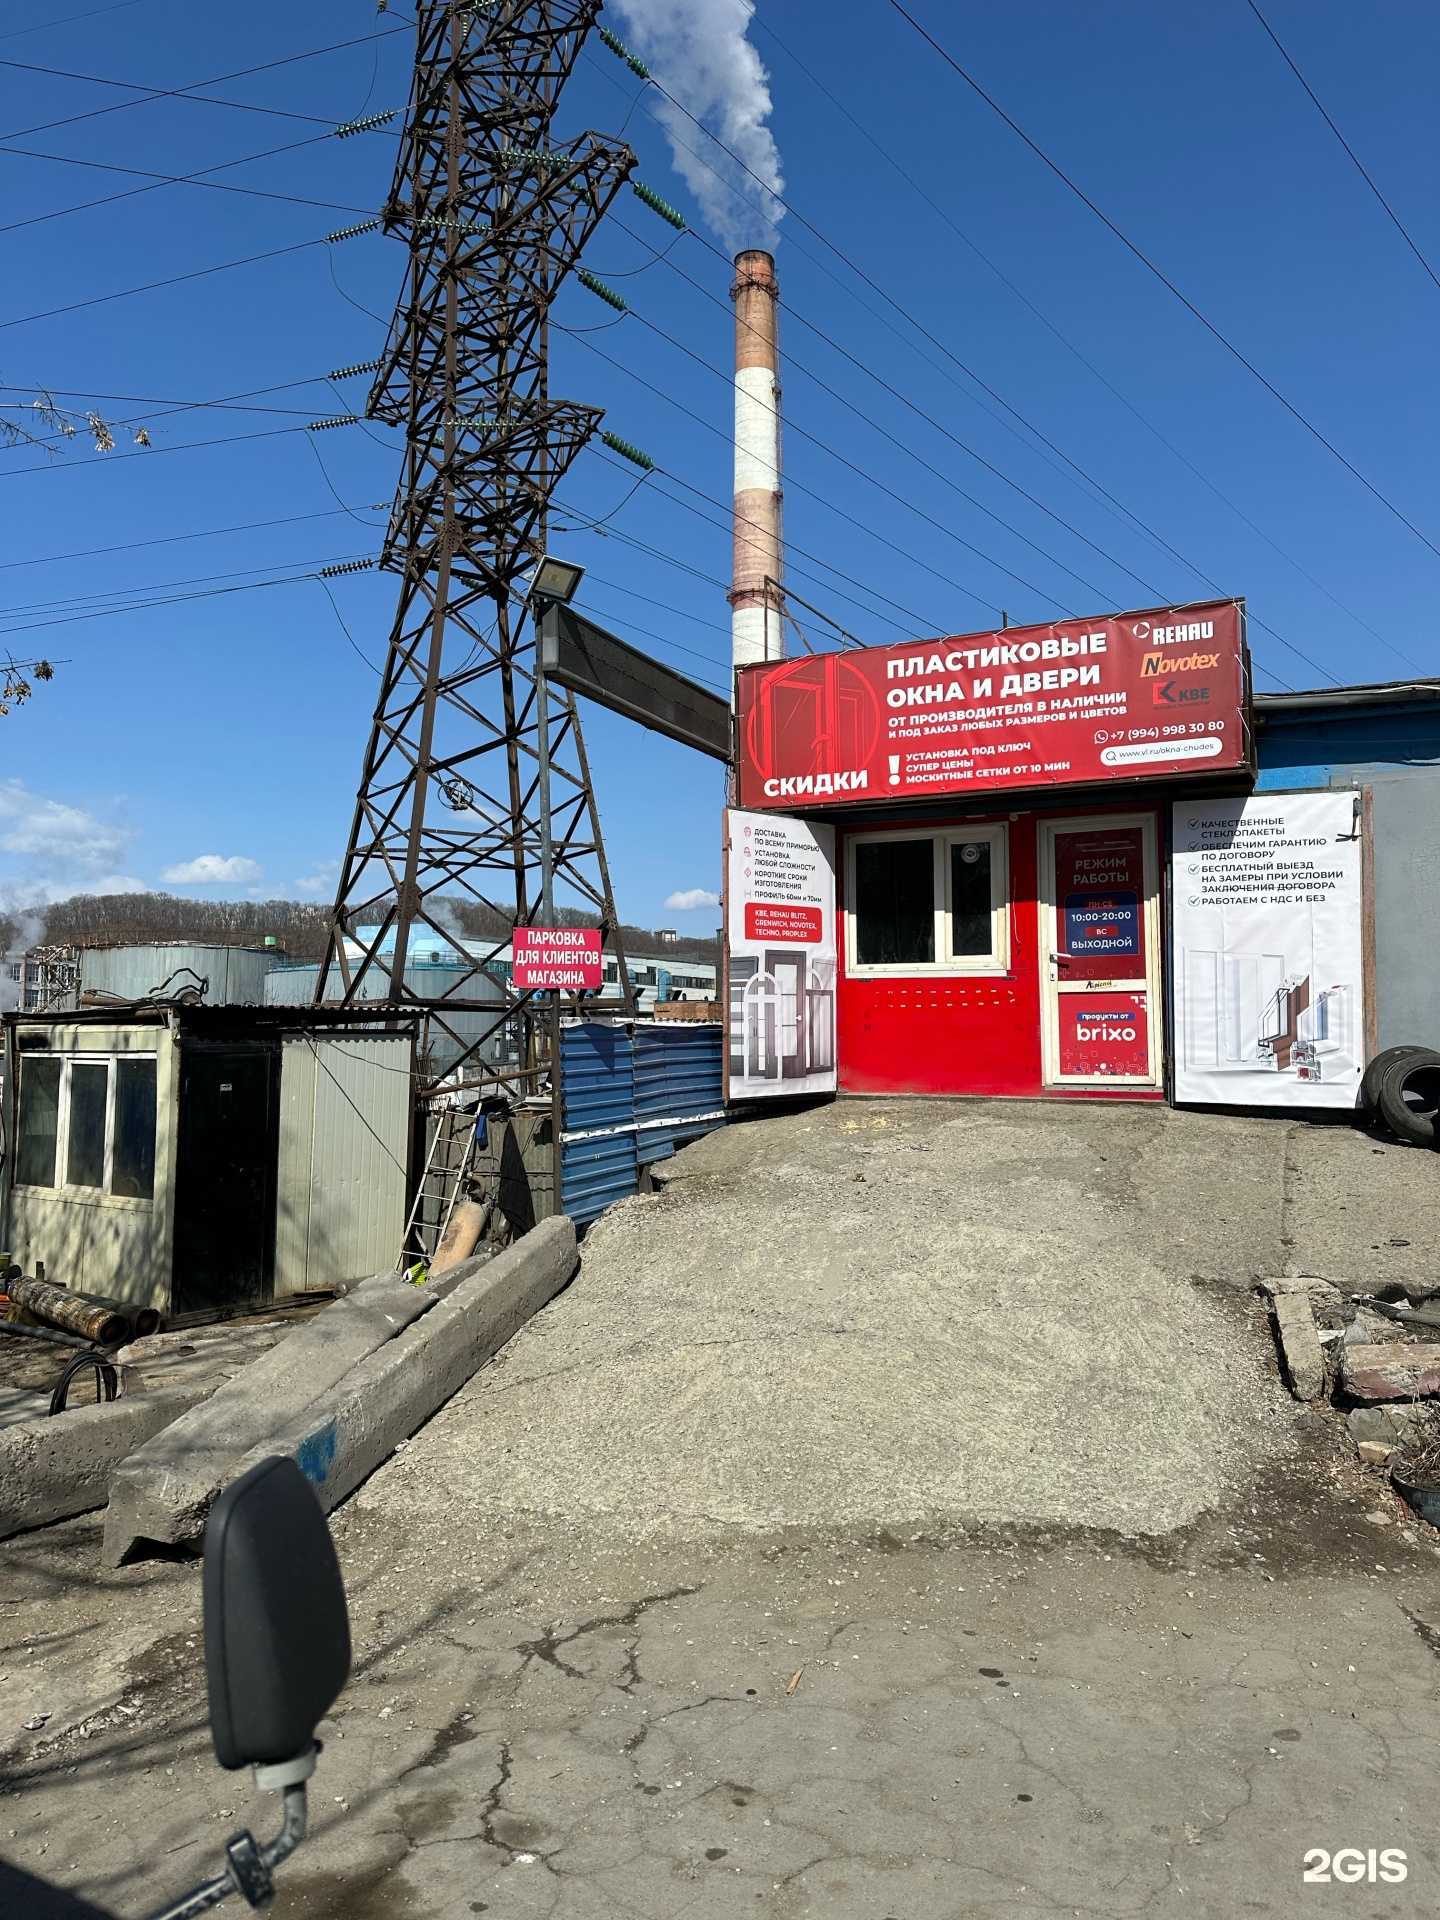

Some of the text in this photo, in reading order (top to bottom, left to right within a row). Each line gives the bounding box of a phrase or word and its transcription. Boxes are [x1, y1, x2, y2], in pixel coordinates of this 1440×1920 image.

[1153, 621, 1214, 646] REHAU
[886, 632, 1108, 680] ПЛАСТИКОВЫЕ
[1140, 651, 1222, 678] Novotex
[886, 664, 1101, 708] ОКНА И ДВЕРИ
[1179, 687, 1211, 702] KBE
[888, 692, 1127, 728] ОТ ПРОИЗВОДИТЕЛЯ В НАЛИЧИИ
[888, 706, 1128, 739] И ПОД ЗАКАЗ ЛЮБЫХ РАЗМЕРОВ И ЦВЕТОВ
[1110, 720, 1225, 741] +7 (994) 998 30 80
[906, 741, 1032, 762] УСТАНОВКА ПОД КЛЮЧ
[906, 759, 974, 773] СУПЕР ЦЕНЫ
[906, 761, 1072, 784] МОСКИТНЫЕ СЕТКИ ОТ 10 МИН
[763, 769, 869, 797] СКИДКИ
[1200, 817, 1285, 829] КАЧЕСТВЕННЫЕ
[754, 828, 787, 839] ДОСТАВКА
[1200, 827, 1286, 839] СТЕКЛОПАКЕТЫ
[754, 837, 821, 853] ПО ВСЕМУ ПРИМОРЬЮ
[1201, 838, 1327, 851] ОБЕСПЕЧИМ ГАРАНТИЮ
[754, 849, 791, 860] УСТАНОВКА
[1218, 850, 1275, 861] ДОГОВОРУ
[754, 858, 817, 872] ЛЮБОЙ СЛОЖНОСТИ
[1075, 857, 1127, 870] РЕЖИМ
[1201, 861, 1314, 873] БЕСПЛАТНЫЙ ВЫЕЗД
[754, 870, 808, 881] КОРОТКИЕ СРОКИ
[1073, 871, 1129, 885] РАБОТЫ
[1219, 873, 1264, 882] ЗАМЕРЫ
[1266, 872, 1289, 881] ПРИ
[1291, 871, 1344, 881] УСЛОВИИ
[754, 879, 802, 890] ИЗГОТОВЛЕНИЯ
[1201, 881, 1336, 893] ЗАКЛЮЧЕНИЯ ДОГОВОРА
[754, 890, 786, 899] ПРОФИЛЬ
[786, 893, 802, 901] 60мм
[1201, 894, 1326, 906] РАБОТАЕМ С НДС И БЕЗ
[1072, 911, 1131, 922] 10:00-20:00
[527, 930, 586, 946] ПАРКОВКА
[1072, 937, 1132, 949] ВЫХОДНОЙ
[515, 949, 600, 966] ДЛЯ КЛИЕНТОВ
[527, 970, 585, 985] МАГАЗИНА
[1076, 1023, 1136, 1041] brixo
